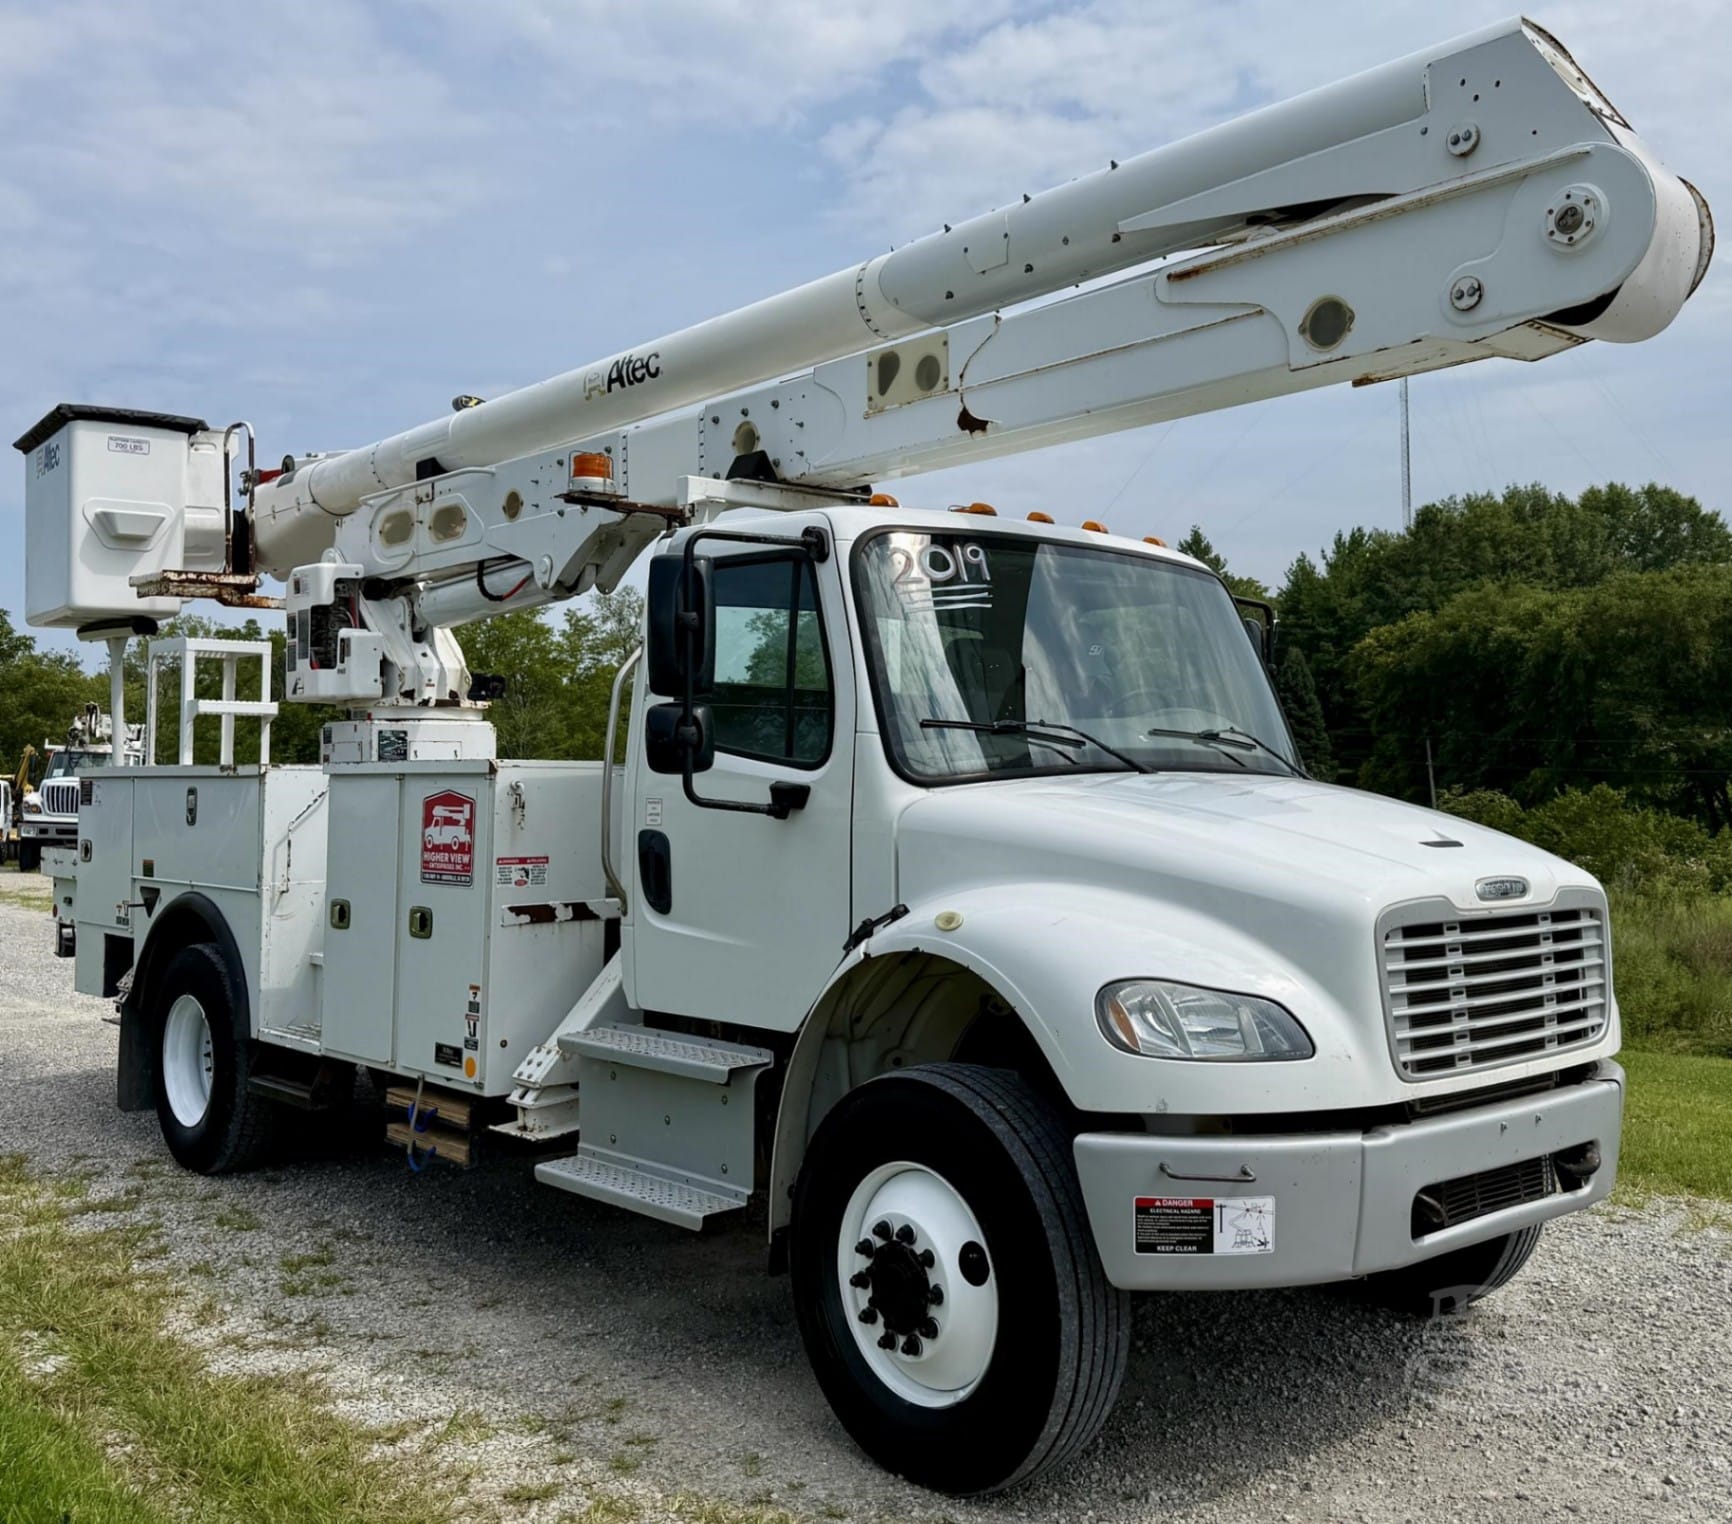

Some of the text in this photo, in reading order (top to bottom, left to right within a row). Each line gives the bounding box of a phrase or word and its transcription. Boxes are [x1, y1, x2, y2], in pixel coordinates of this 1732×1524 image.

[607, 352, 660, 393] Altec
[115, 442, 128, 450] 700
[888, 542, 991, 586] 2019
[423, 851, 471, 864] HIGHER VIEW
[1162, 1199, 1193, 1207] DANGER
